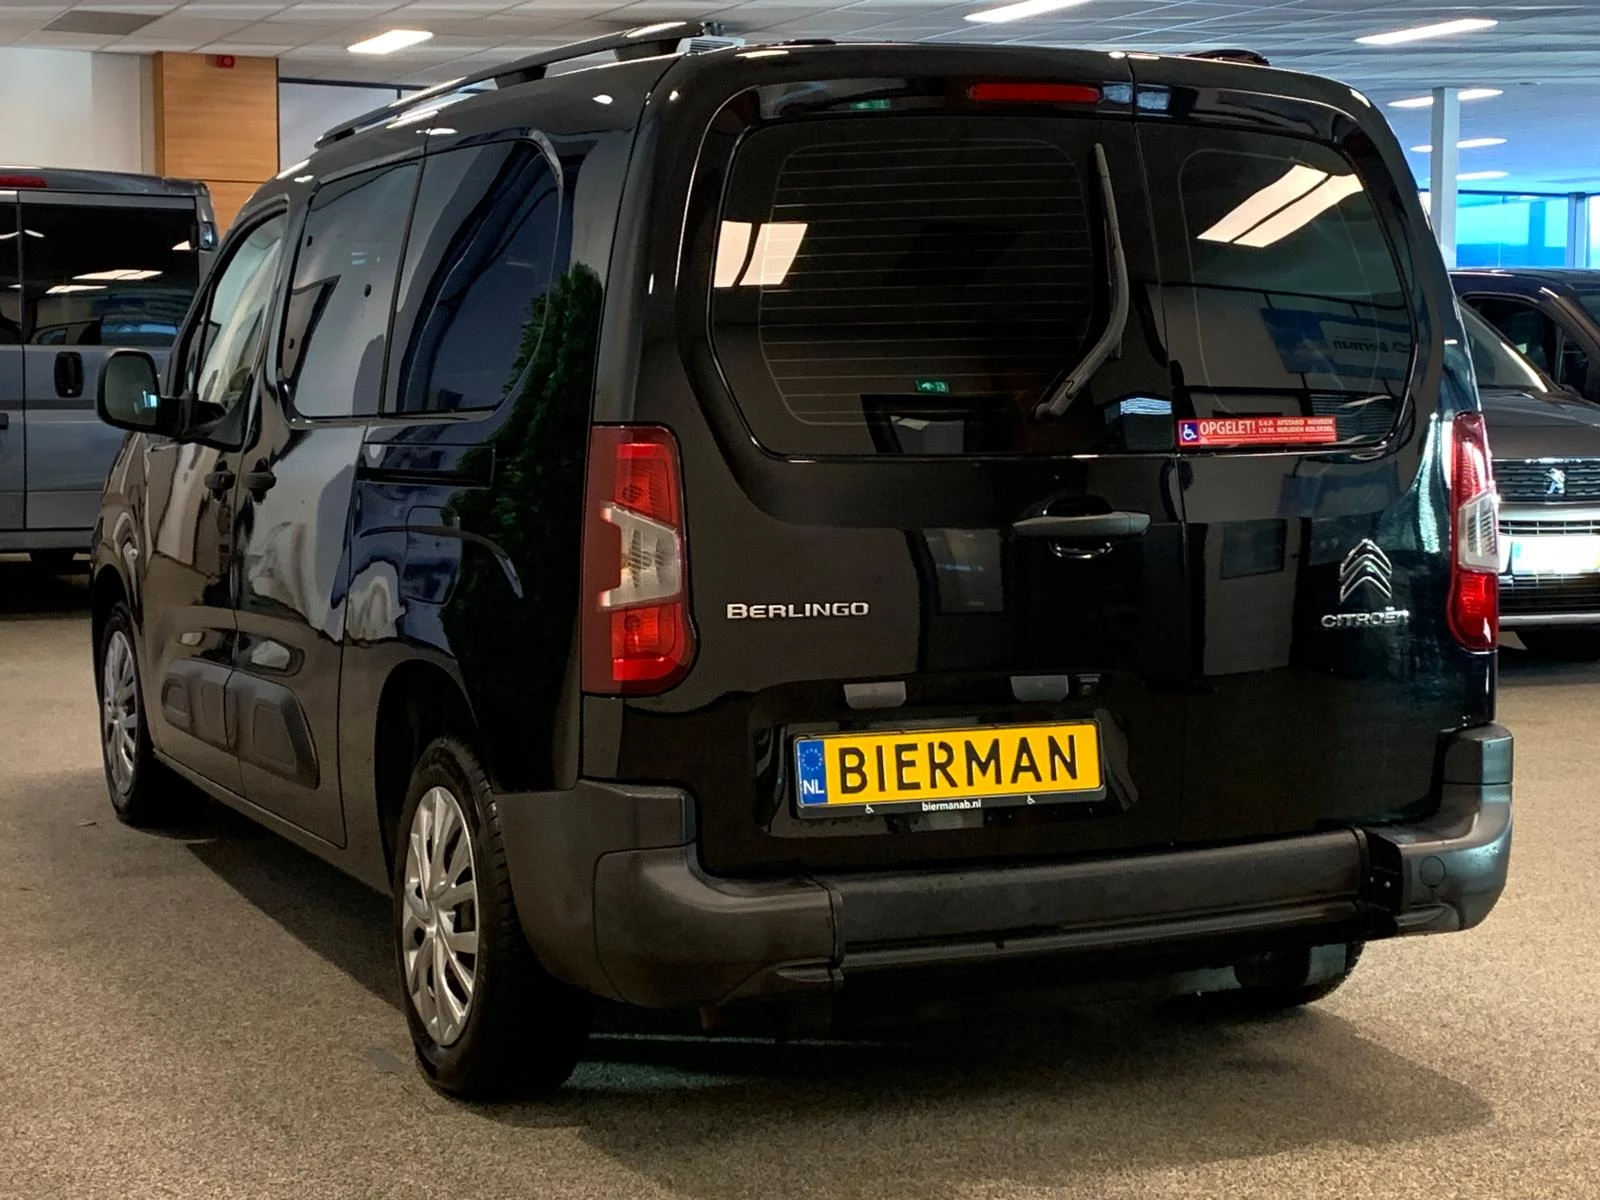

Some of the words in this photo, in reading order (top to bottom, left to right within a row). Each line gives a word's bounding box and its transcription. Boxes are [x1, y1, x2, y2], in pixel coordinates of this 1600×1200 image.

[1200, 420, 1256, 435] OPGELET!
[726, 602, 870, 619] BERLINGO
[838, 734, 1078, 795] BIERMAN
[803, 778, 825, 796] NL
[921, 799, 982, 812] biermanab.nl
